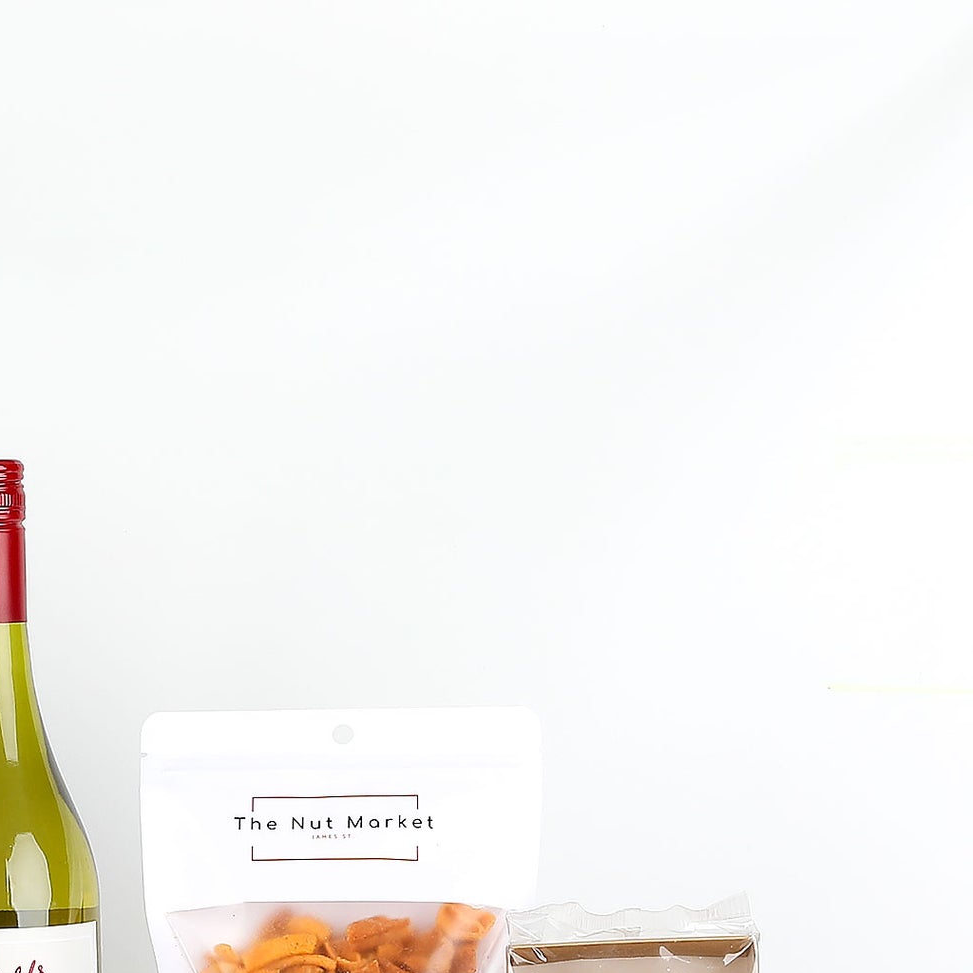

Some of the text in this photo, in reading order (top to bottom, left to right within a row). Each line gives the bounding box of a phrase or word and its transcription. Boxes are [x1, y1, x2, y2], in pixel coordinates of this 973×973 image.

[234, 814, 434, 831] The Nut Market
